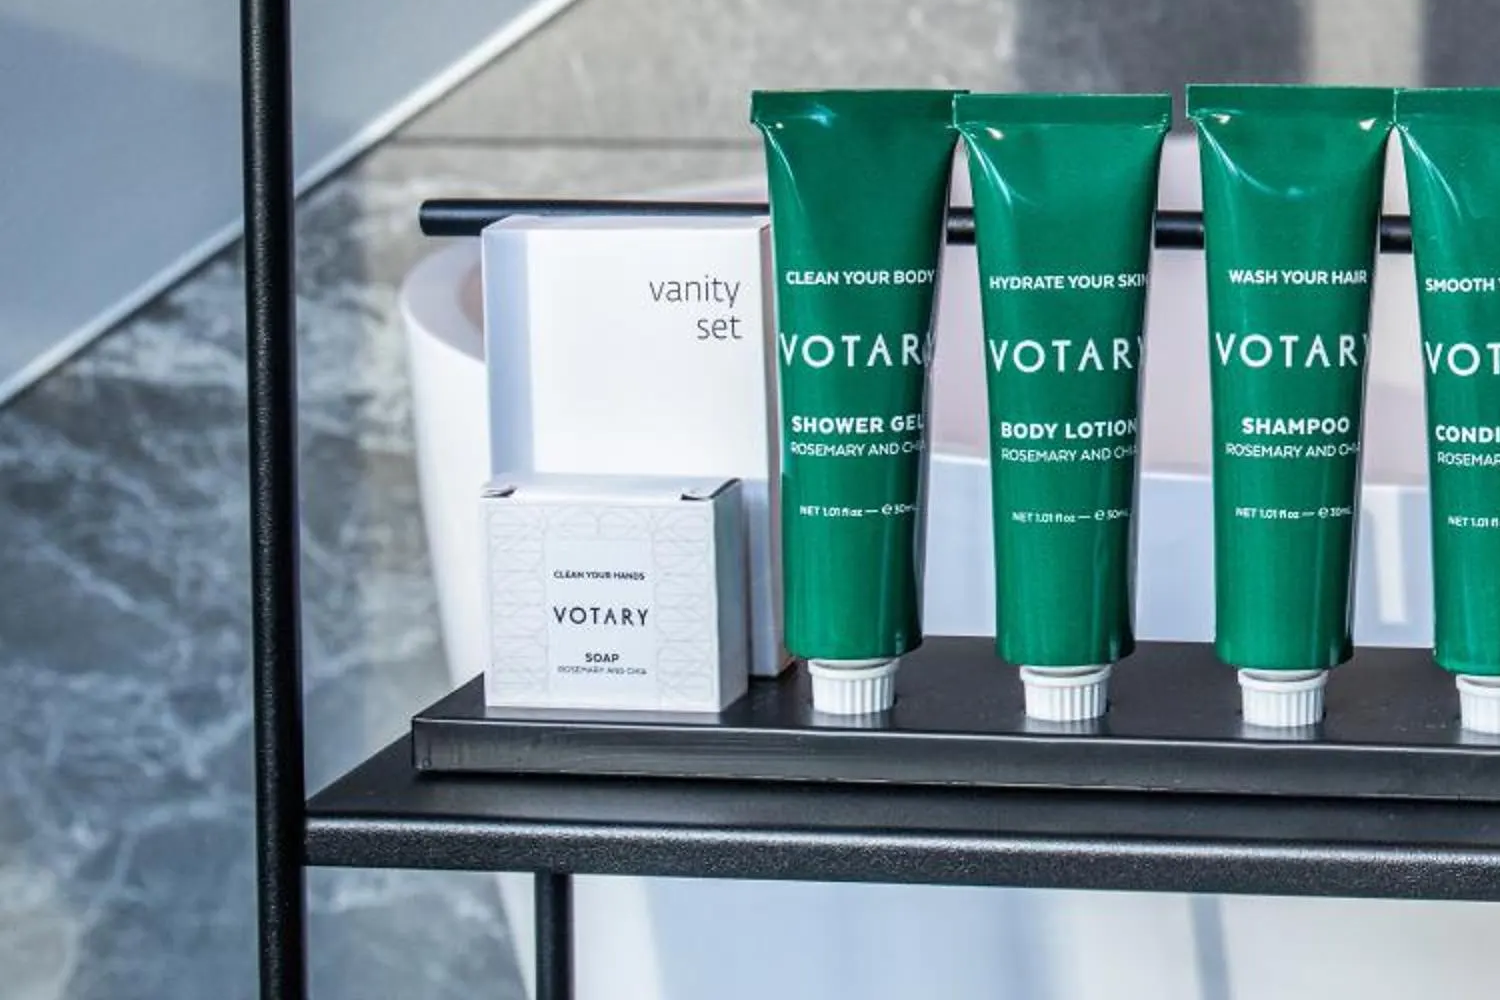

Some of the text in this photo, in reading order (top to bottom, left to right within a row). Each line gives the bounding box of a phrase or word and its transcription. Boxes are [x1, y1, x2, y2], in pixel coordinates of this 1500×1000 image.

[785, 269, 935, 285] CLEAN YOUR BODY
[989, 273, 1148, 289] HYDRATE YOUR SKIN
[1228, 269, 1368, 285] WASH YOUR HAIR
[1425, 277, 1495, 292] SMOOTH
[649, 274, 740, 308] vanity
[697, 315, 743, 340] set
[791, 414, 925, 434] SHOWER GEL
[1000, 419, 1137, 439] BODY LOTION
[1241, 416, 1350, 435] SHAMPOO
[790, 441, 865, 457] ROSEMARY
[868, 442, 899, 455] AND
[1001, 447, 1077, 462] ROSEMARY
[1080, 447, 1111, 461] AND
[1225, 442, 1303, 458] ROSEMARY
[1305, 444, 1335, 457] AND
[800, 505, 819, 516] NET
[1012, 511, 1033, 522] NET
[1235, 507, 1256, 518] NET
[1448, 516, 1468, 527] NET
[553, 570, 584, 579] CLEAN
[613, 571, 645, 580] HANDS
[553, 606, 648, 627] VOTARY
[584, 652, 620, 662] SOAP
